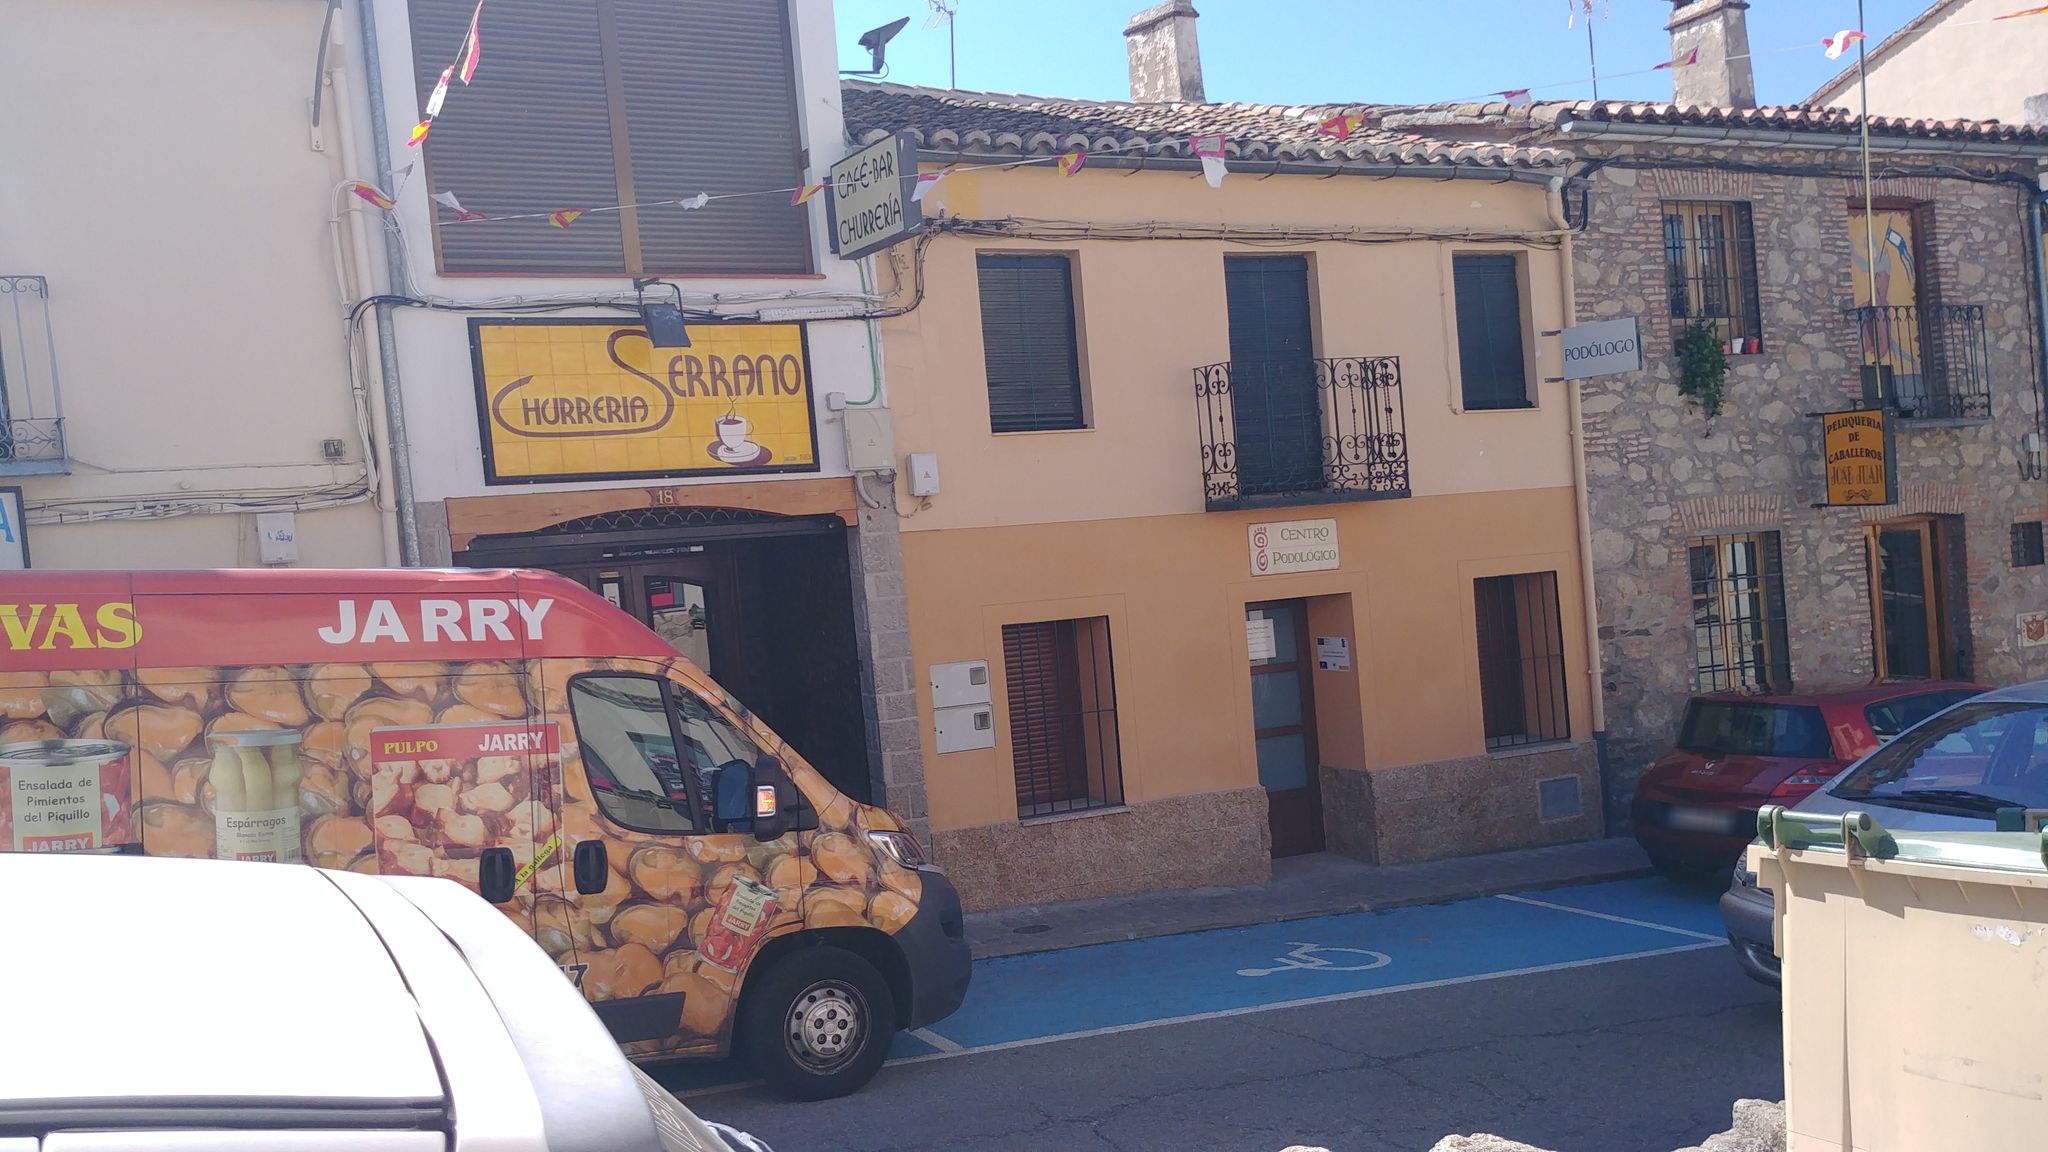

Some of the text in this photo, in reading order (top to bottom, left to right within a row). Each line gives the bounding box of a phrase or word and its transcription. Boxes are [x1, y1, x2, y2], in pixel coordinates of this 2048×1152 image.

[837, 150, 894, 200] CAFÉ-BAR
[839, 192, 903, 246] CHURRERÍA
[1564, 338, 1636, 362] PODÓLOGO
[606, 328, 802, 418] SERRANO
[492, 374, 651, 438] CHURRERIA
[1826, 415, 1882, 435] PELUQUERIA
[1848, 431, 1860, 442] DE
[1828, 447, 1882, 465] CABALLEROS
[658, 489, 674, 505] 18
[1280, 526, 1329, 542] CENTRO
[317, 598, 555, 645] JARRY
[383, 739, 439, 755] PULPO
[478, 731, 544, 752] JARRY
[18, 777, 92, 791] Ensalada de
[26, 795, 86, 807] Pimientos
[23, 808, 90, 824] del Piquillo
[226, 816, 287, 831] Espárragos
[27, 837, 90, 853] JARRY
[558, 962, 589, 989] 7
